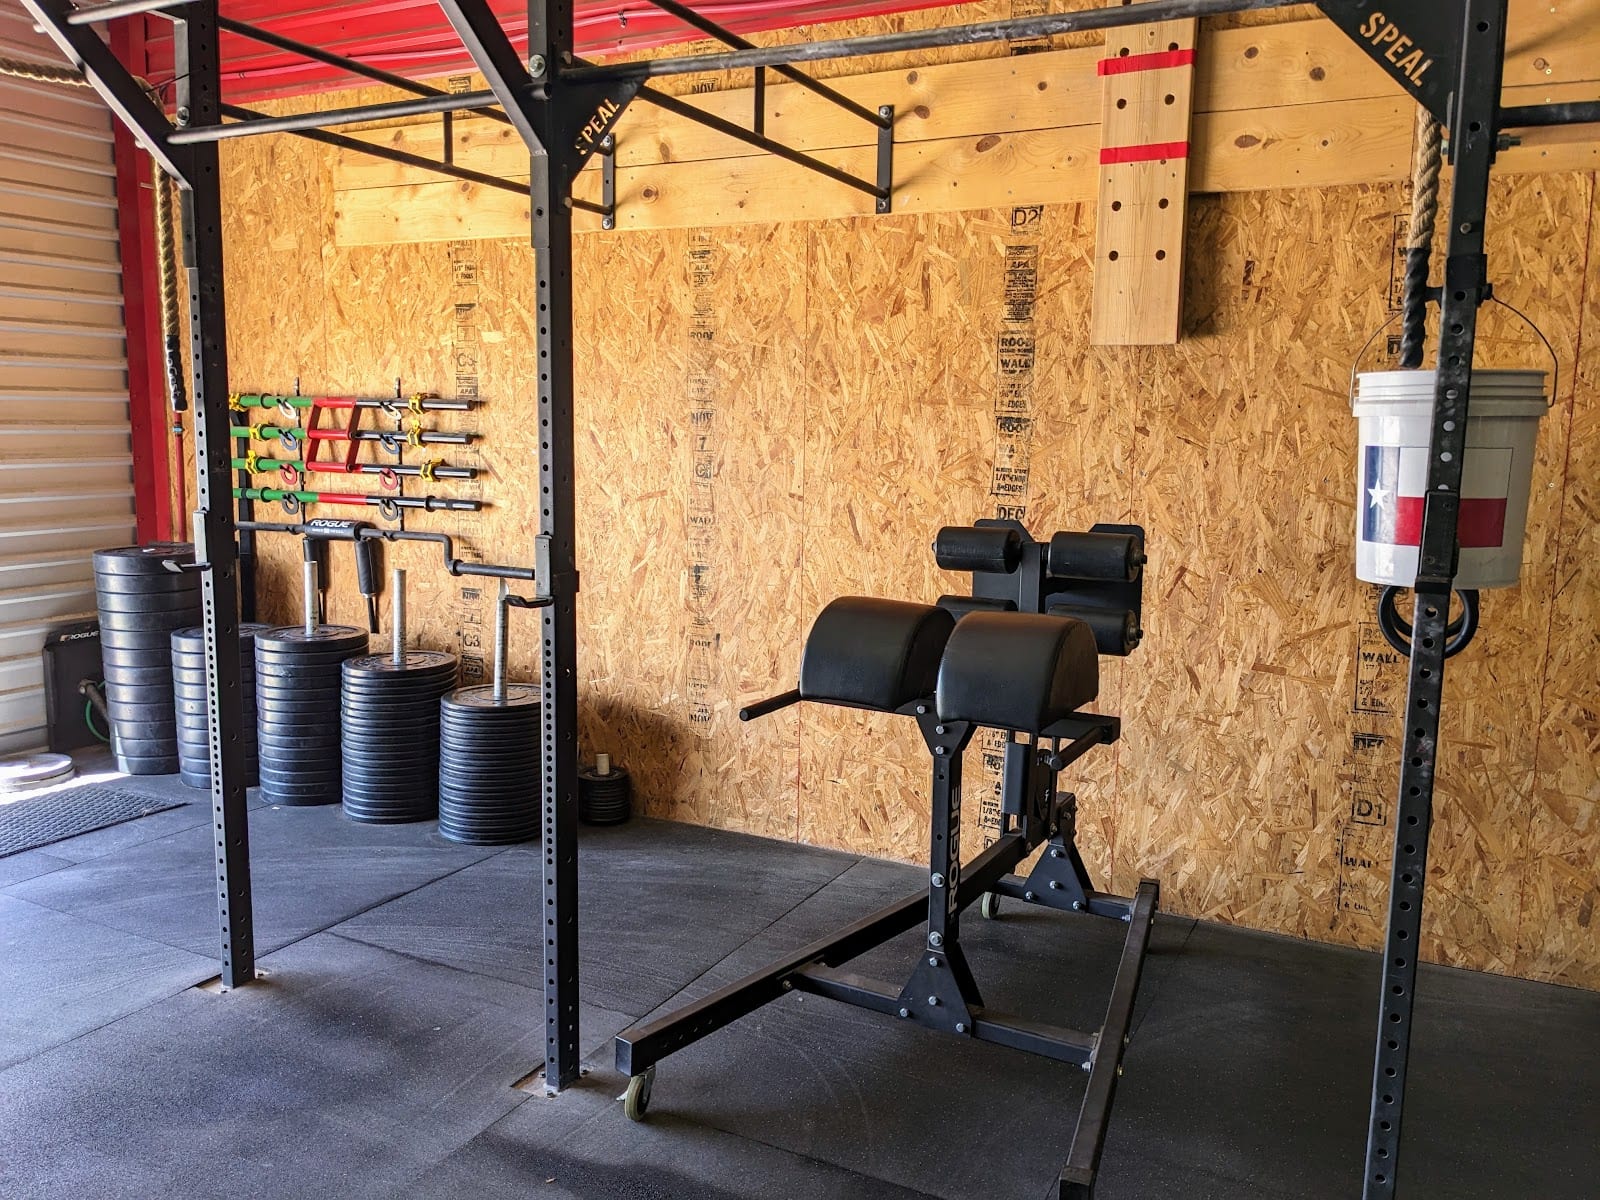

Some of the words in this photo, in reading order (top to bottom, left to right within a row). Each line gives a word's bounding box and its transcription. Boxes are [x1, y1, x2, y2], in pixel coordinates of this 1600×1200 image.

[1359, 12, 1433, 87] SPEAL
[575, 98, 620, 155] SPEAL
[1014, 209, 1038, 226] D2
[999, 507, 1024, 520] DEC
[310, 520, 353, 528] ROGUE
[465, 634, 480, 647] C3
[1357, 799, 1383, 820] D1
[948, 785, 961, 914] ROGUE
